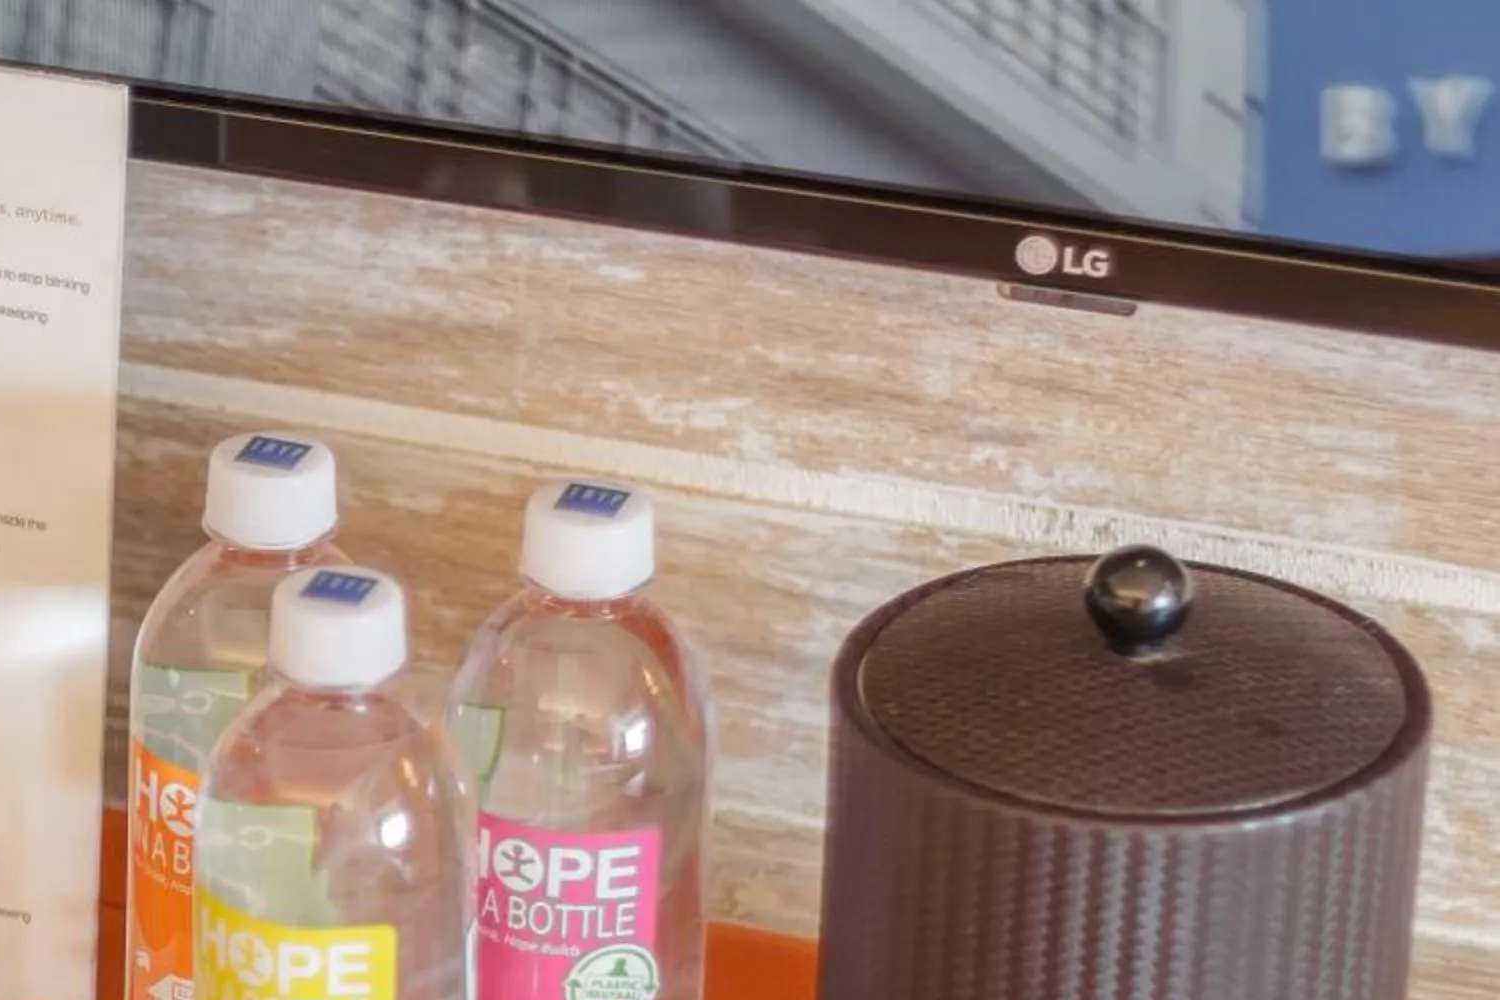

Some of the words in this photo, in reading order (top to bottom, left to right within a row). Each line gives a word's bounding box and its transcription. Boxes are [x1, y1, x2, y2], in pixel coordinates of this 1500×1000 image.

[15, 204, 82, 226] anytime.
[1062, 246, 1110, 278] LG
[45, 275, 91, 295] blinking
[135, 755, 197, 837] HO
[508, 895, 637, 940] BOTTLE
[201, 903, 372, 997] HOPE
